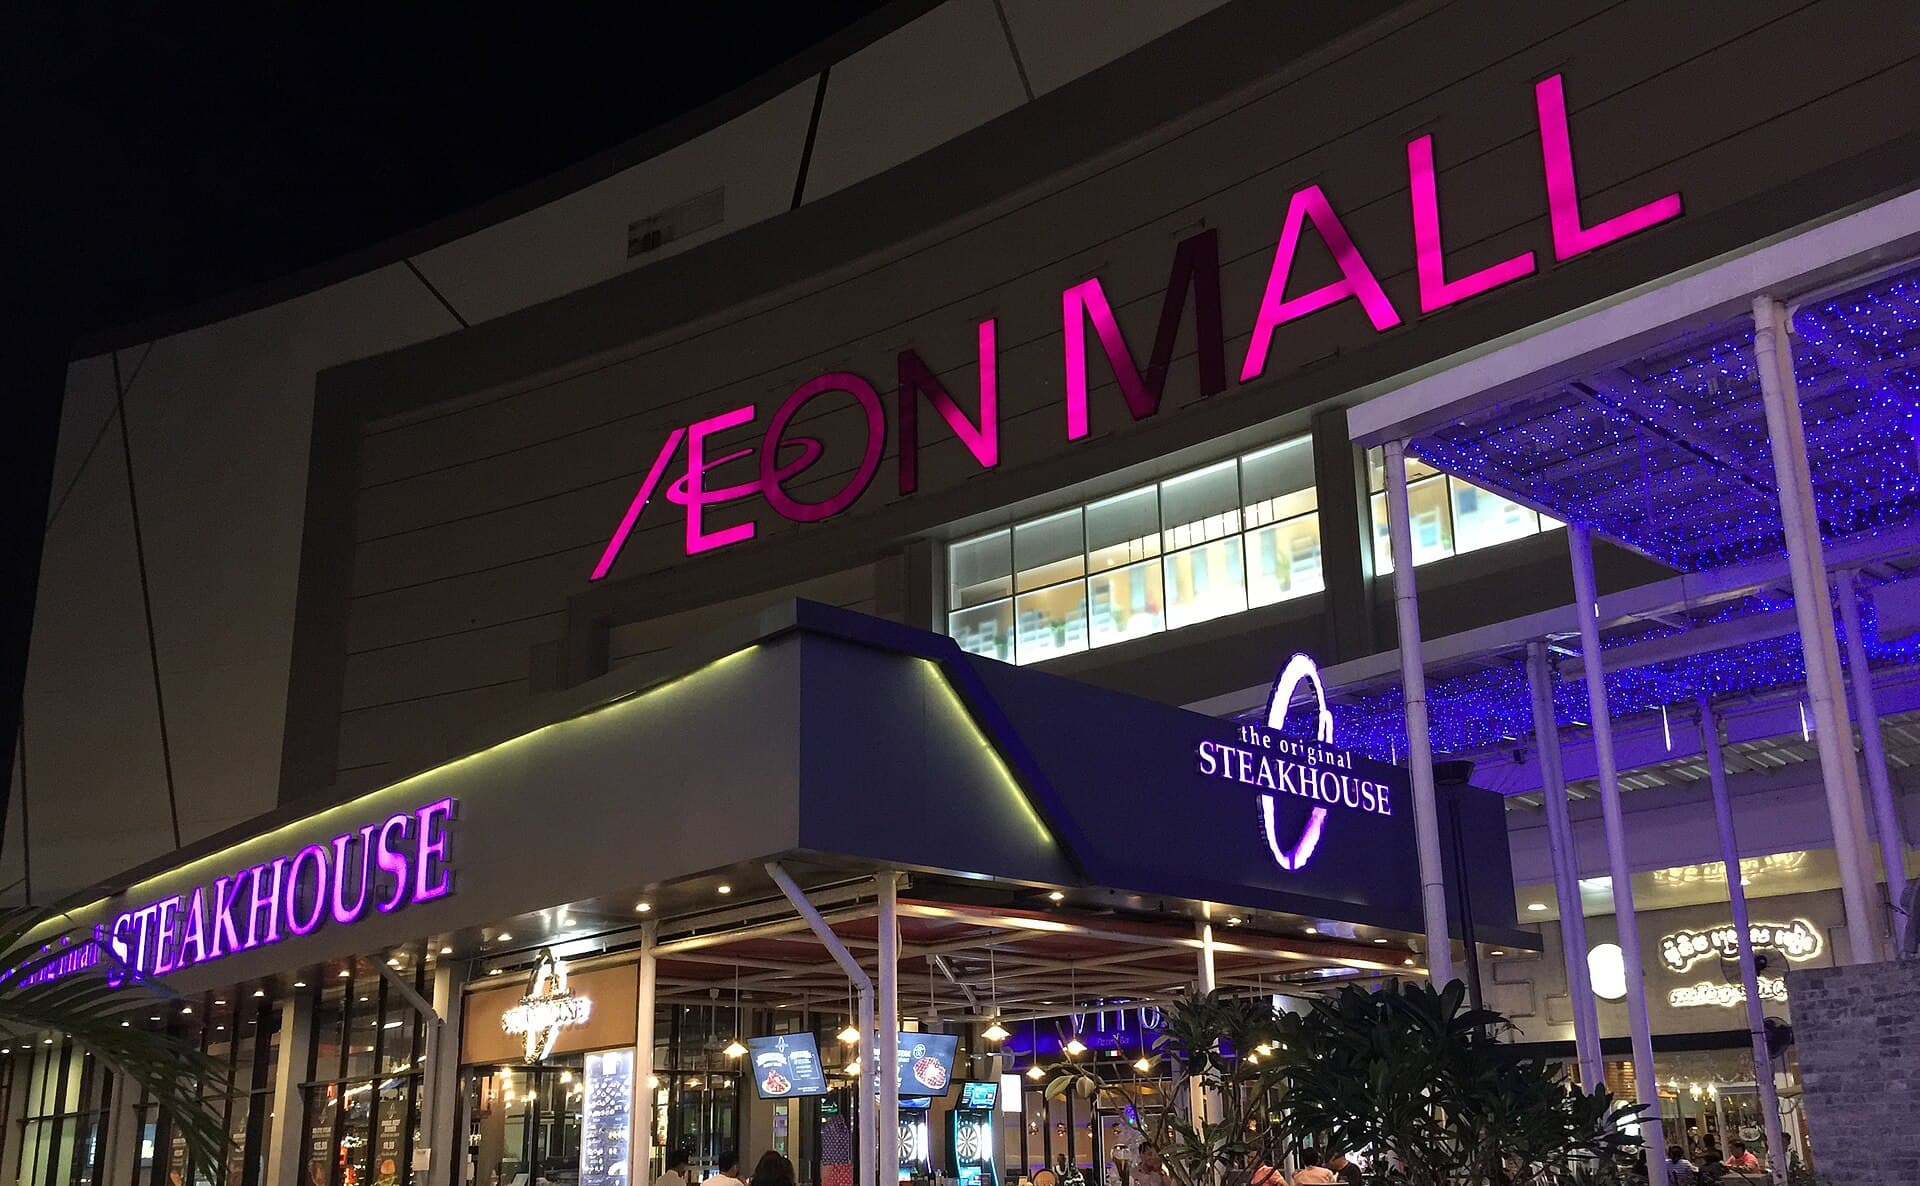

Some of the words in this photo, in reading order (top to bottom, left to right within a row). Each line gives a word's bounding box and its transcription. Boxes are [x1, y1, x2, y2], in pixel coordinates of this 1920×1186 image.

[1061, 72, 1685, 443] MALL
[1199, 741, 1391, 815] STEAKHOUSE
[1241, 725, 1271, 749] the
[1280, 740, 1353, 770] original
[107, 797, 457, 989] STEAKHOUSE
